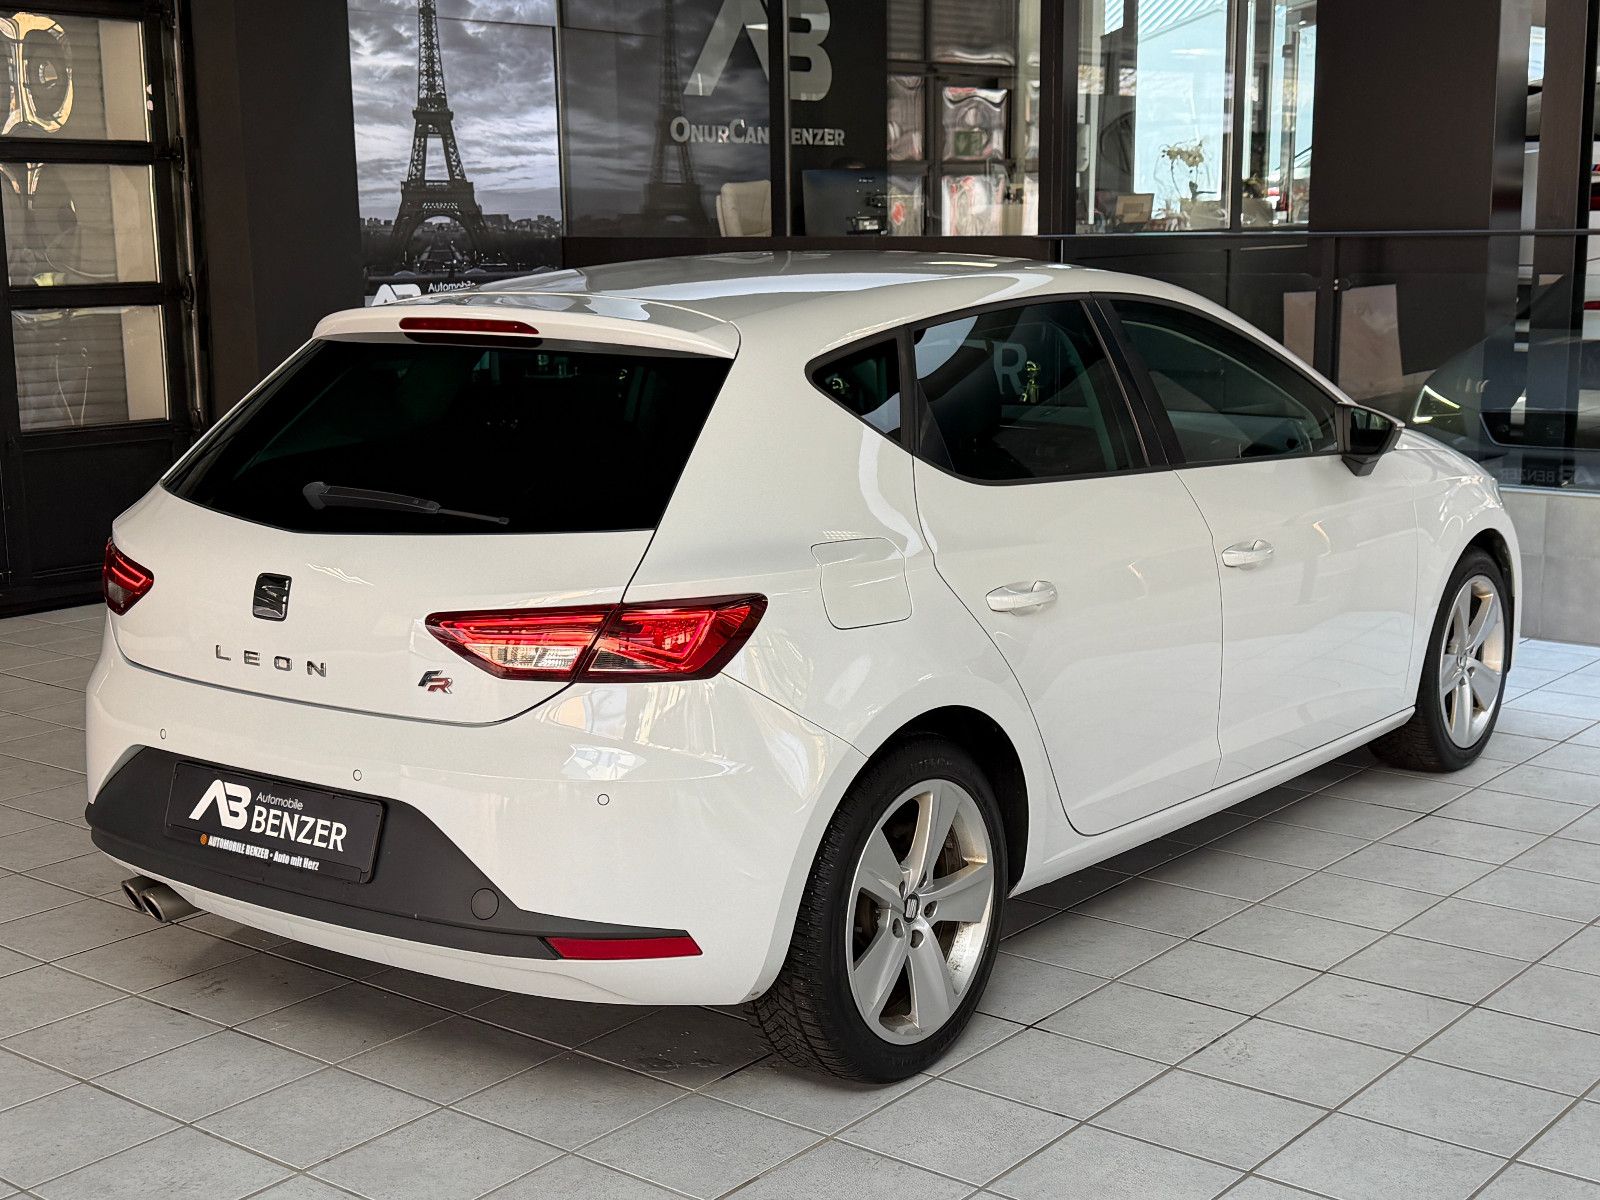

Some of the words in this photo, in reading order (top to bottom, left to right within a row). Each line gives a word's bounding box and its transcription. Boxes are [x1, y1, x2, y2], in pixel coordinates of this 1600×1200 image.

[791, 128, 845, 146] ENZER
[215, 644, 328, 678] LEON
[418, 669, 454, 694] FR
[189, 779, 251, 830] AB
[256, 792, 304, 811] Automobile
[250, 805, 347, 852] BENZER
[208, 835, 246, 853] AUTOMOBILE
[246, 845, 270, 859] BENZER
[273, 851, 290, 865] Auto
[290, 855, 303, 867] mit
[303, 857, 320, 871] Herz
